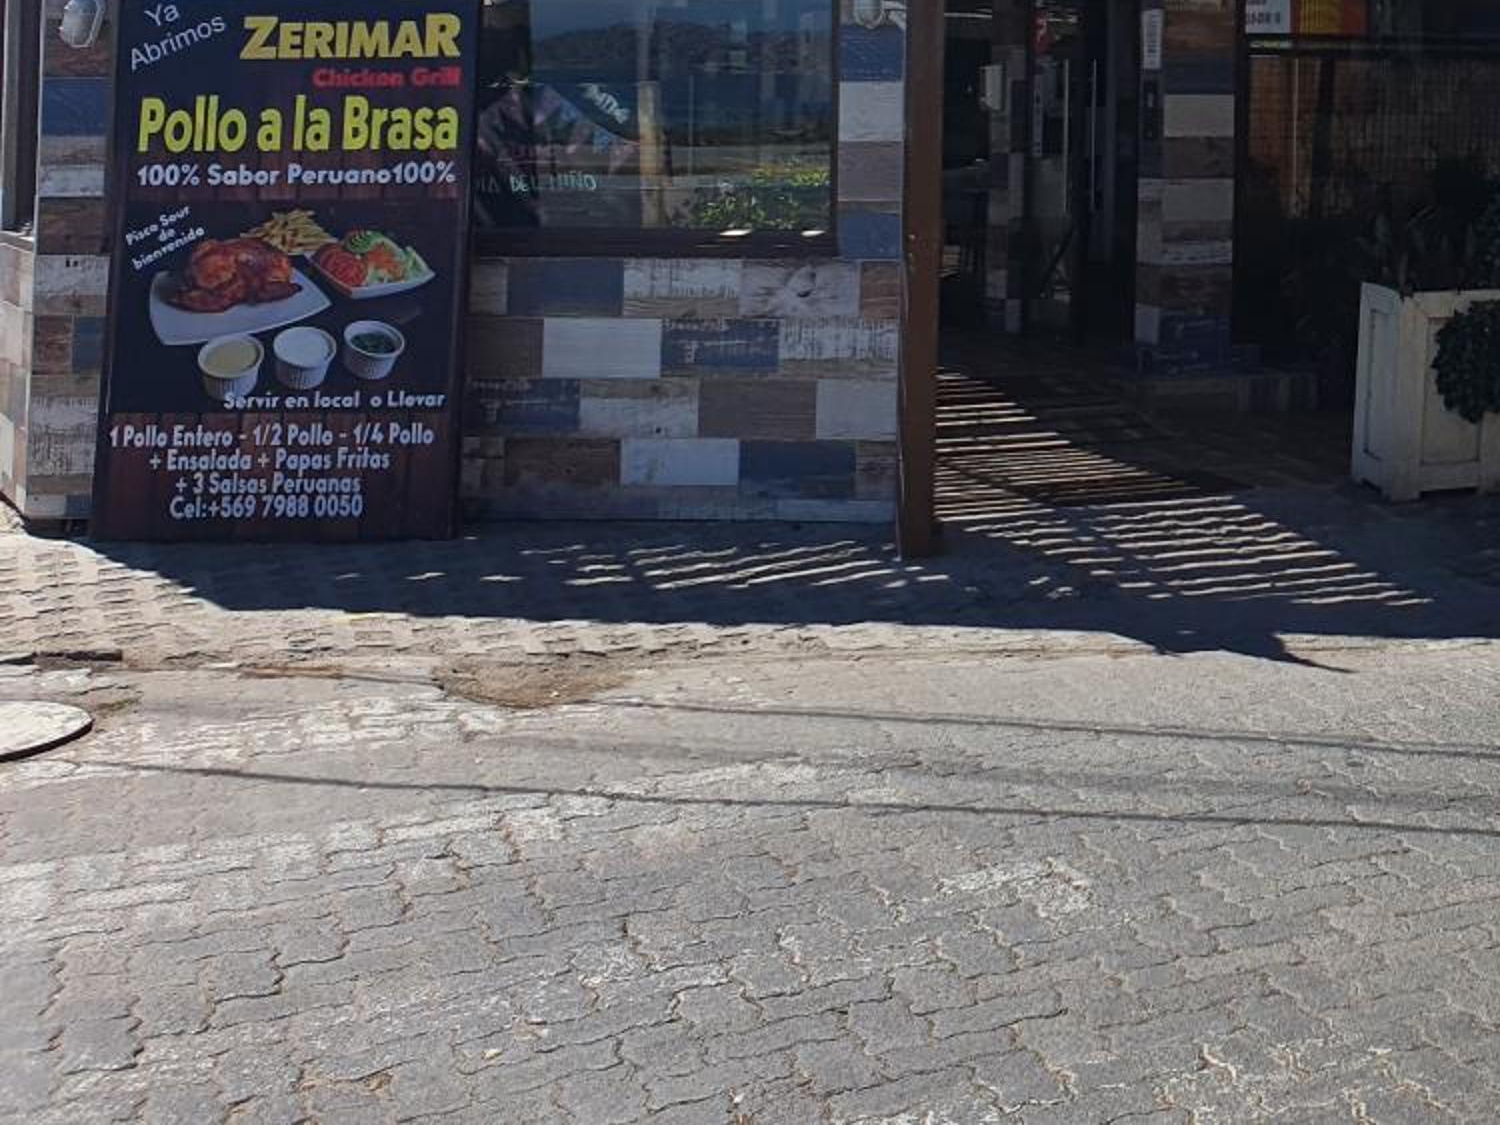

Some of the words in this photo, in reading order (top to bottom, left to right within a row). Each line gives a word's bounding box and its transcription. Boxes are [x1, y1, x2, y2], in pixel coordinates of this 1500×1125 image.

[144, 2, 180, 26] Ya
[129, 14, 226, 71] Abrimos
[239, 12, 462, 61] ZERIMAR
[137, 94, 248, 153] Pollo
[256, 106, 283, 152] a
[292, 94, 332, 152] la
[341, 94, 460, 152] Brasa
[136, 163, 200, 187] 100%
[206, 162, 281, 187] Sabor
[223, 390, 280, 409] Servir
[284, 394, 310, 409] en
[314, 389, 361, 409] local
[370, 394, 382, 409] o
[108, 424, 119, 448] 1
[122, 424, 168, 448] Pollo
[172, 423, 234, 448] Entero
[252, 422, 282, 447] 1/2
[286, 422, 334, 447] Pollo
[352, 421, 385, 446] 1/4
[388, 421, 435, 446] Pollo
[166, 448, 254, 472] Ensalada
[274, 446, 332, 478] Papas
[336, 446, 391, 471] Fritas
[191, 472, 204, 495] 3
[208, 471, 268, 495] Salsas
[271, 470, 362, 494] Peruanas
[261, 493, 310, 519] 7988
[314, 492, 364, 518] 0050
